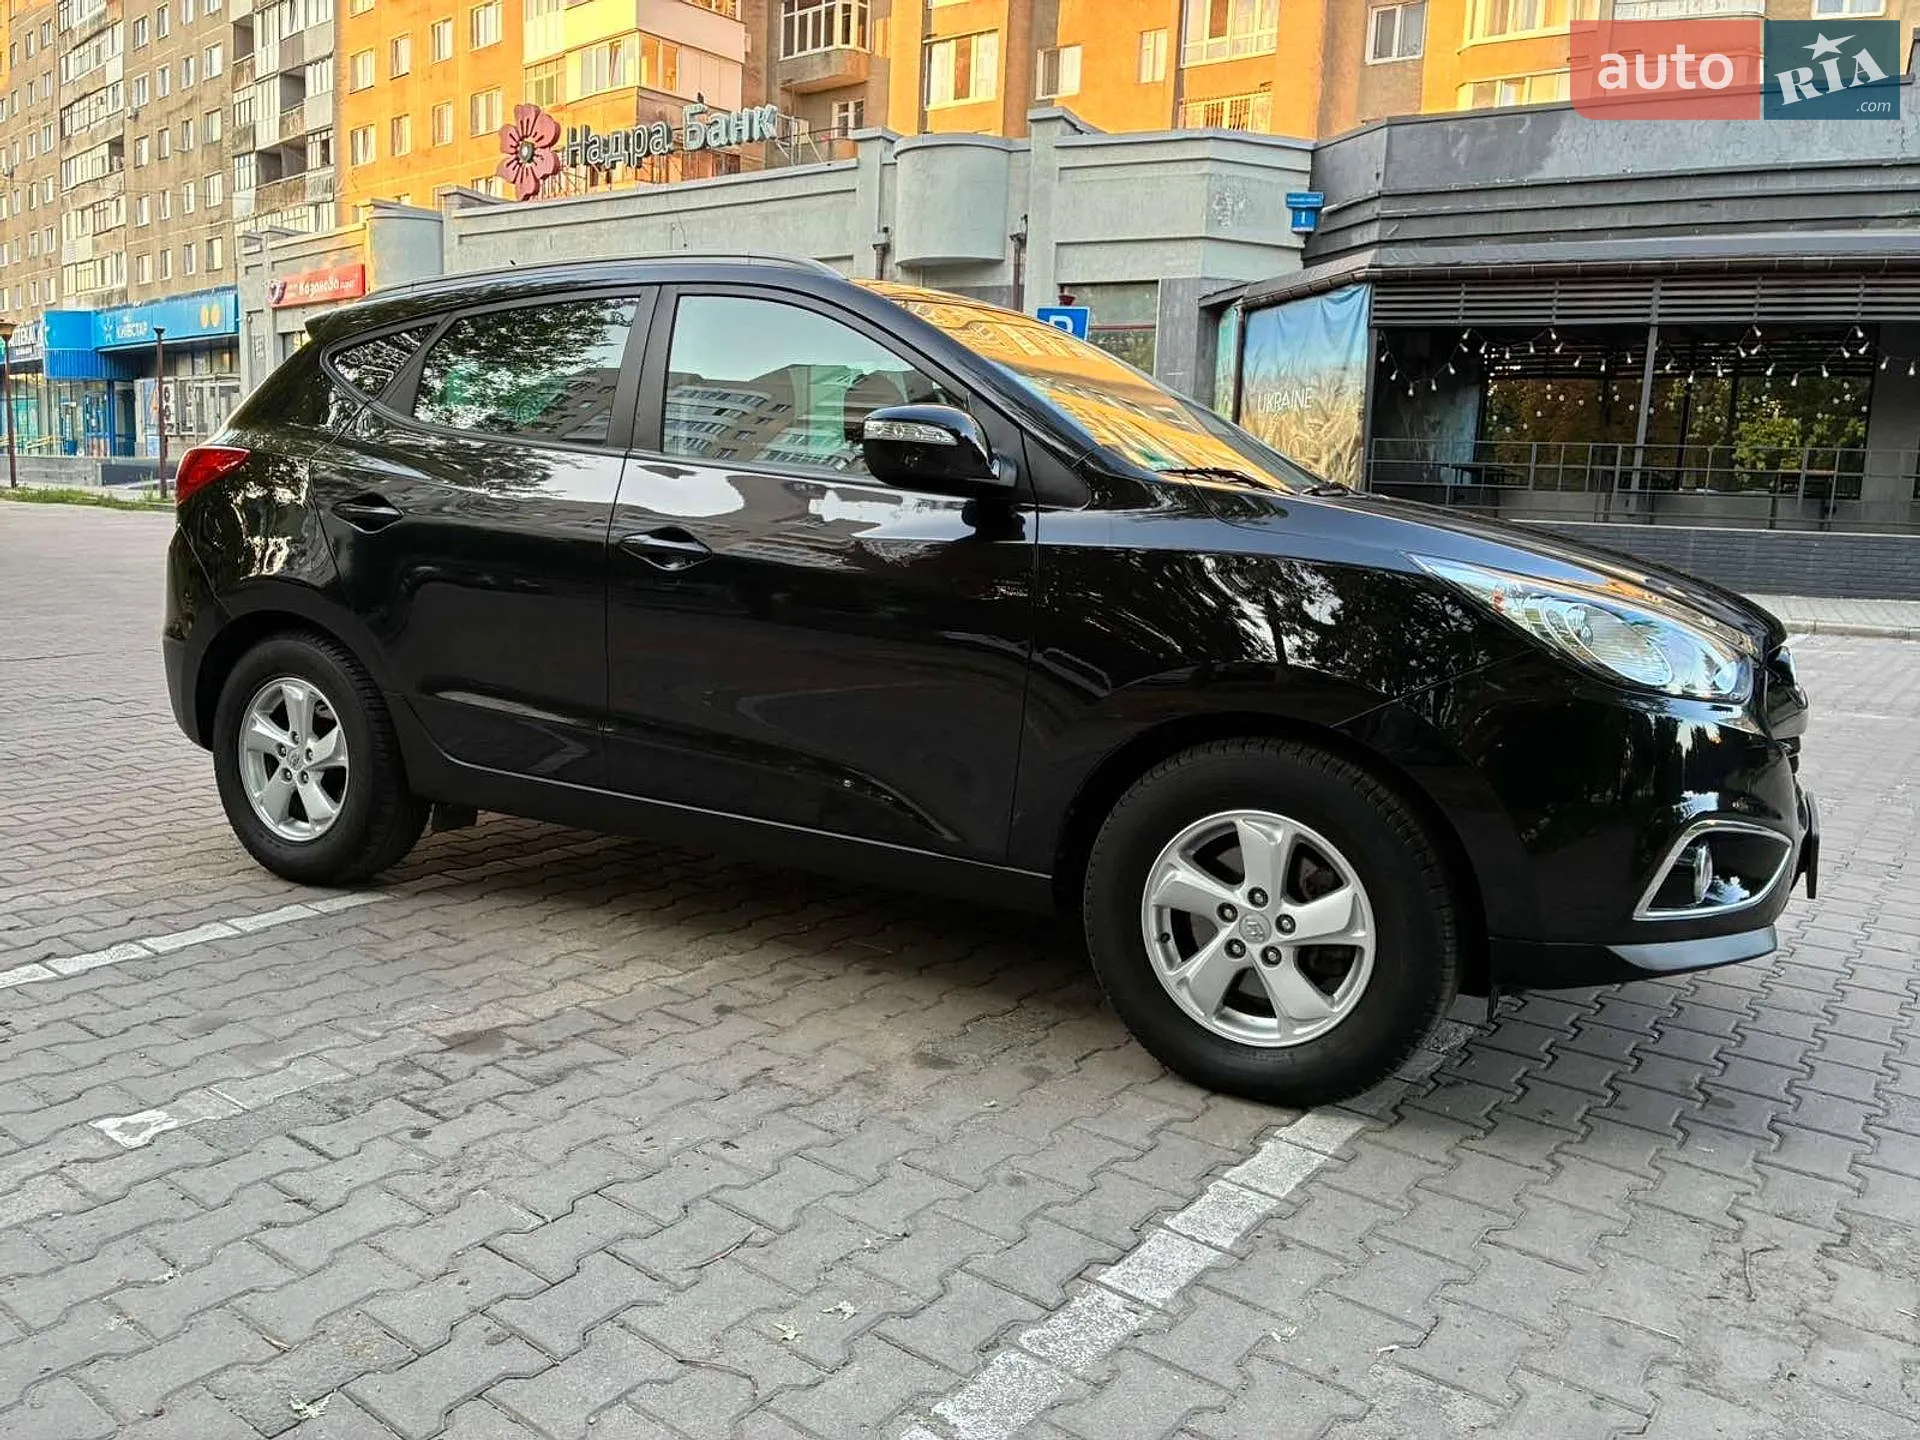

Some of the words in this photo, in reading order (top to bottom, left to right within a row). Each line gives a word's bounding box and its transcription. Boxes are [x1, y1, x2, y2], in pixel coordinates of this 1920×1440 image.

[566, 120, 672, 169] Надра
[683, 104, 778, 151] Банк
[1257, 387, 1312, 413] UKRAINE
